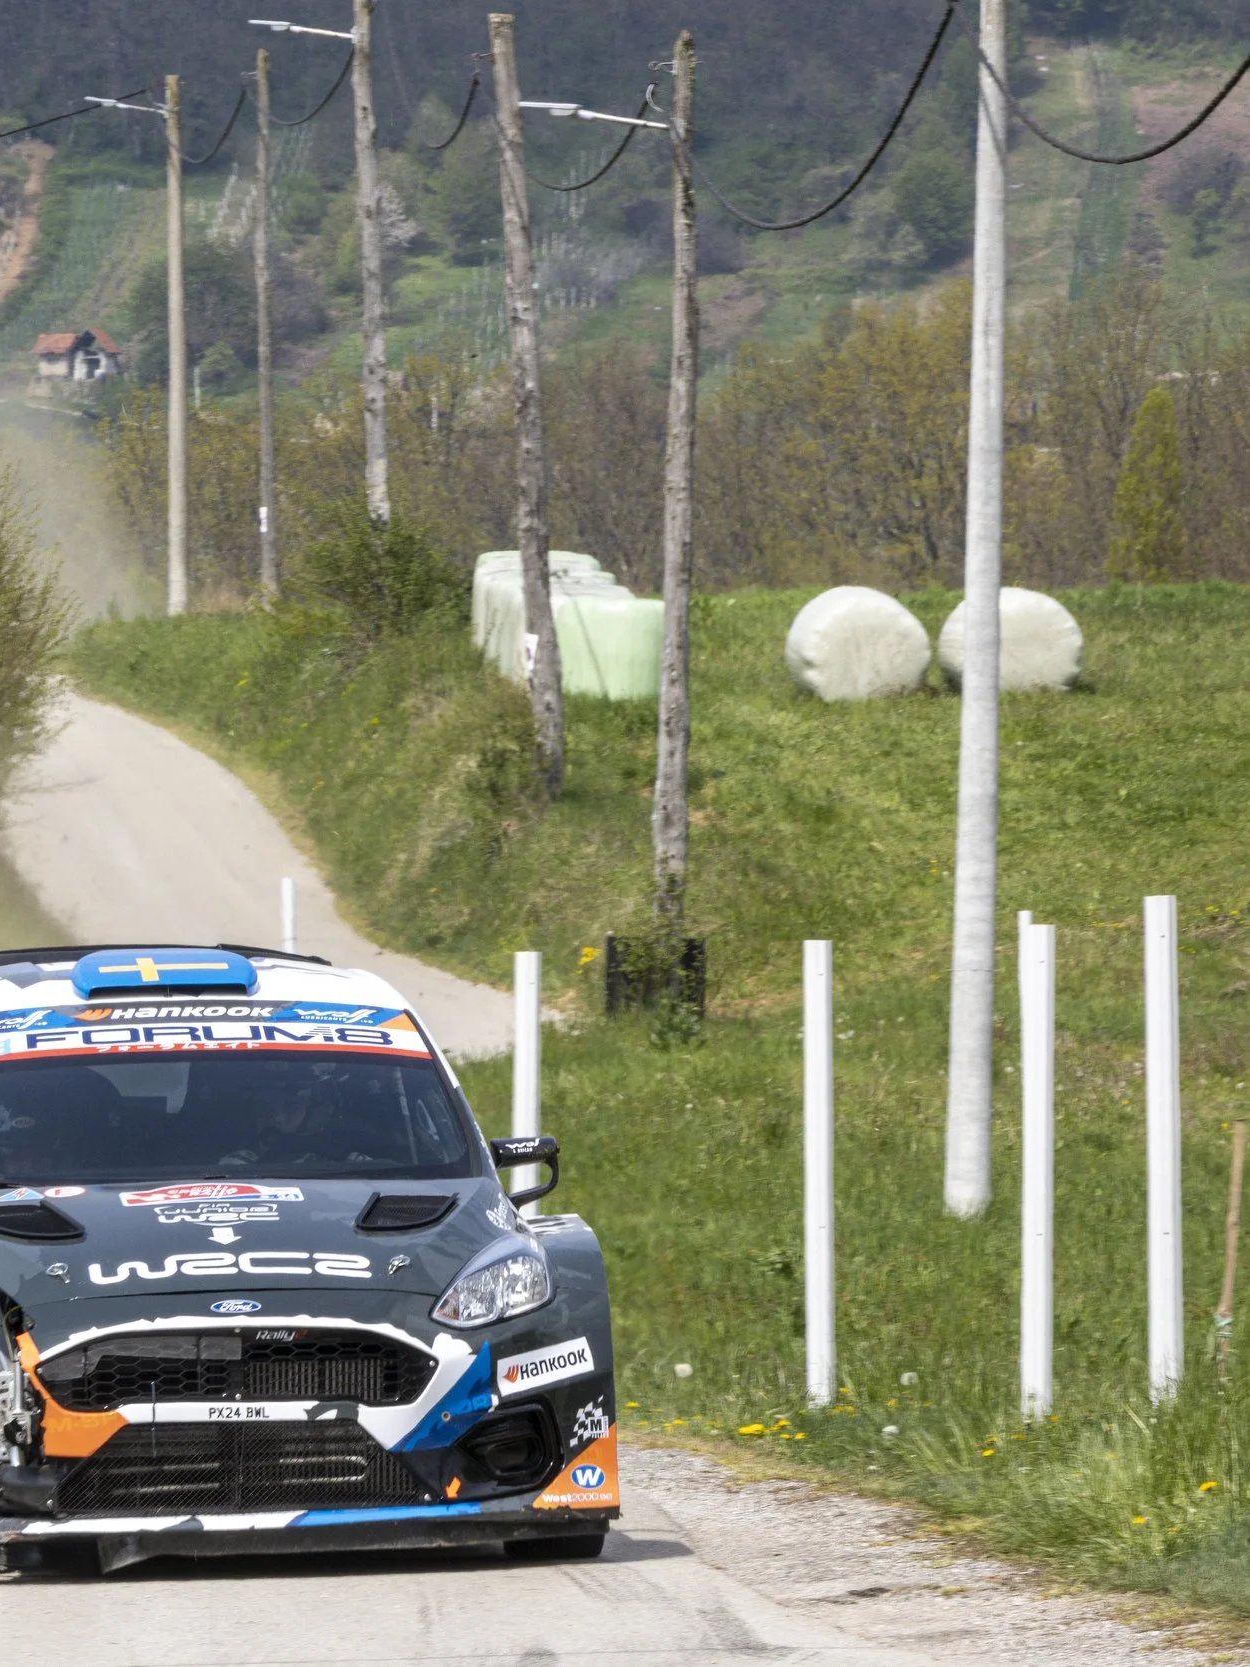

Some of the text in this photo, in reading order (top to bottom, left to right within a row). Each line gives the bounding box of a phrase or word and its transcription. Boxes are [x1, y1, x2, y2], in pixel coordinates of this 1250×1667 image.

[25, 1024, 394, 1050] FORUM8
[88, 1251, 373, 1285] WRC2
[218, 1301, 253, 1313] Ford
[208, 1406, 270, 1420] PX24 BWL
